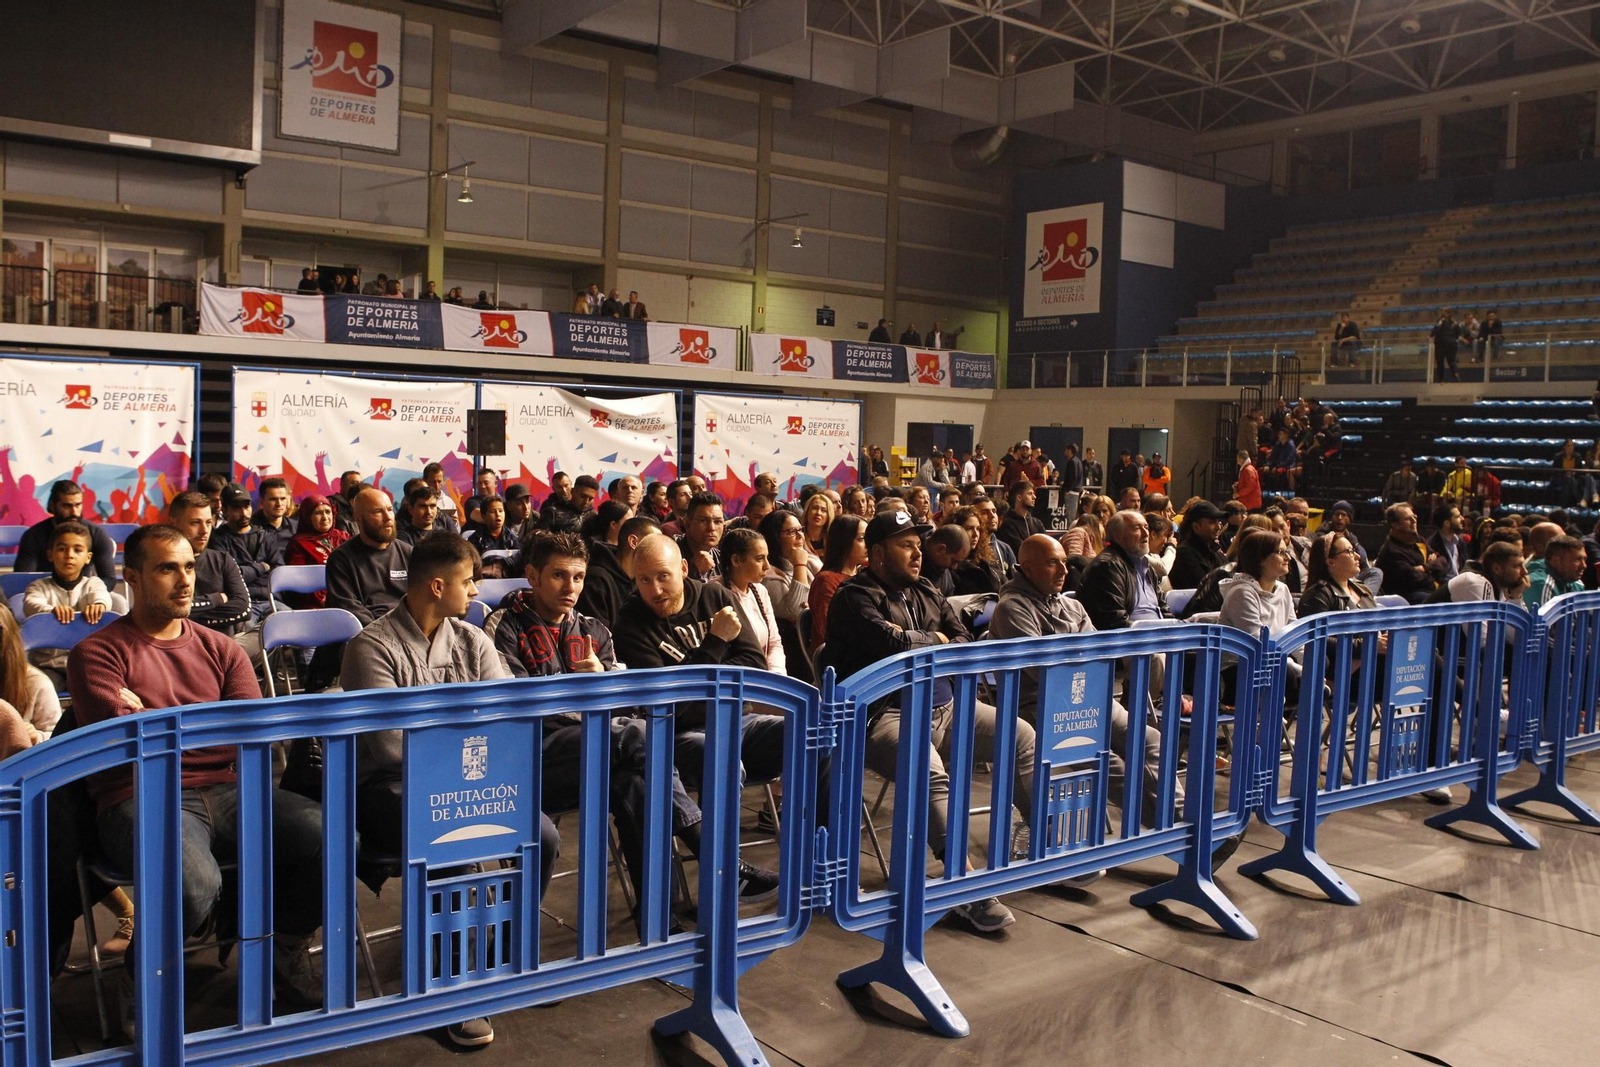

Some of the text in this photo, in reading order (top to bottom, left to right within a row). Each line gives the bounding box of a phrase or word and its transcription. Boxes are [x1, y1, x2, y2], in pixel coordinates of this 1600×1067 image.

[310, 96, 376, 115] DEPORTES
[310, 108, 376, 126] DE ALMERIA
[346, 306, 418, 320] DEPORTES
[347, 316, 418, 330] DE ALMERIA
[570, 324, 628, 336] DEPORTES
[571, 334, 628, 346] DE ALMERIA
[846, 349, 892, 360] DEPORTES
[846, 358, 892, 369] DE ALMERIA
[956, 362, 992, 372] DEPORTES
[103, 392, 168, 402] DEPORTES
[282, 393, 348, 408] ALMERÍA
[103, 402, 176, 412] DE ALMERIA
[281, 408, 316, 417] CIUDAD
[400, 405, 454, 414] DEPORTES
[520, 404, 574, 417] ALMERÍA
[400, 414, 414, 422] DE
[417, 414, 462, 423] ALMERIA
[615, 417, 661, 425] DEPORTES
[727, 412, 772, 425] ALMERÍA
[808, 422, 845, 430] DEPORTES
[1396, 664, 1426, 675] DIPUTACIÓN
[1053, 707, 1100, 722] DIPUTACIÓN
[1054, 718, 1098, 734] DE ALMERÍA
[430, 783, 518, 806] DIPUTACIÓN
[432, 798, 516, 822] DE ALMERÍA
